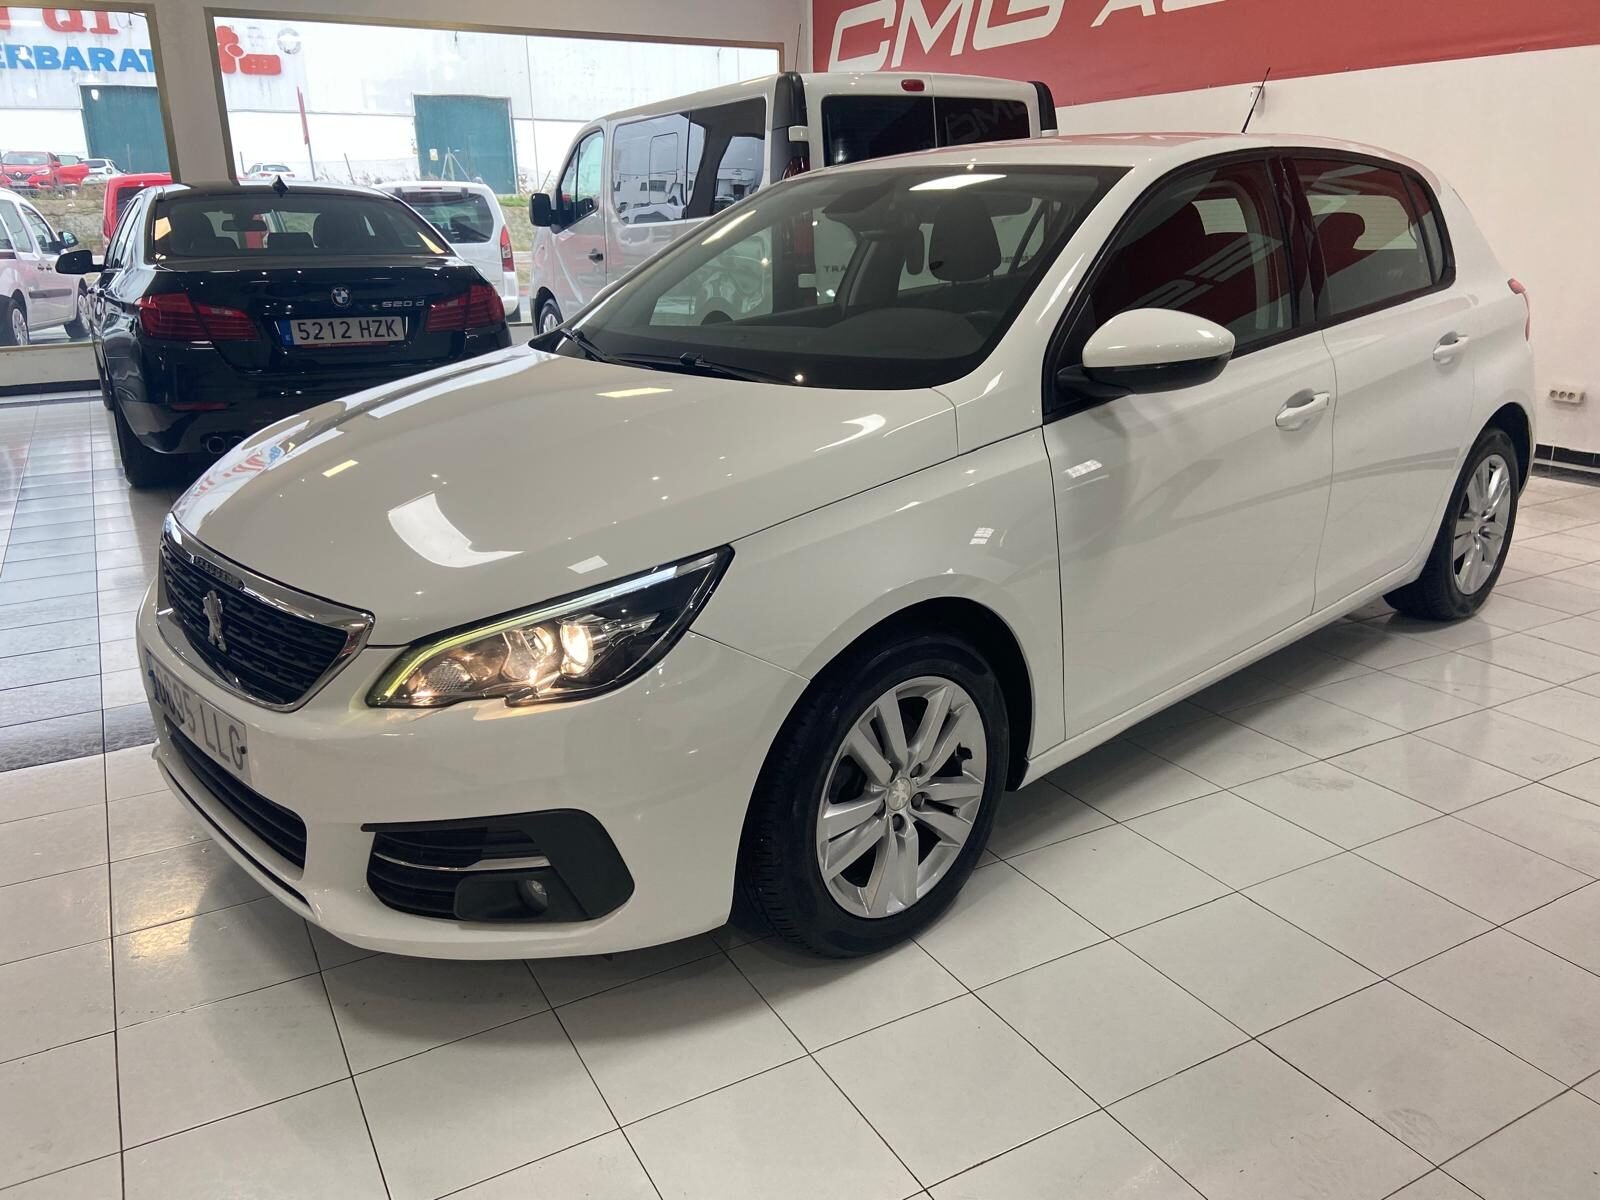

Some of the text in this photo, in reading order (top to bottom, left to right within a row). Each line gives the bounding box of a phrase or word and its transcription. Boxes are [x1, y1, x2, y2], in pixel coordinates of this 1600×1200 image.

[296, 319, 398, 340] 5212 HZK
[199, 703, 244, 771] LLG
